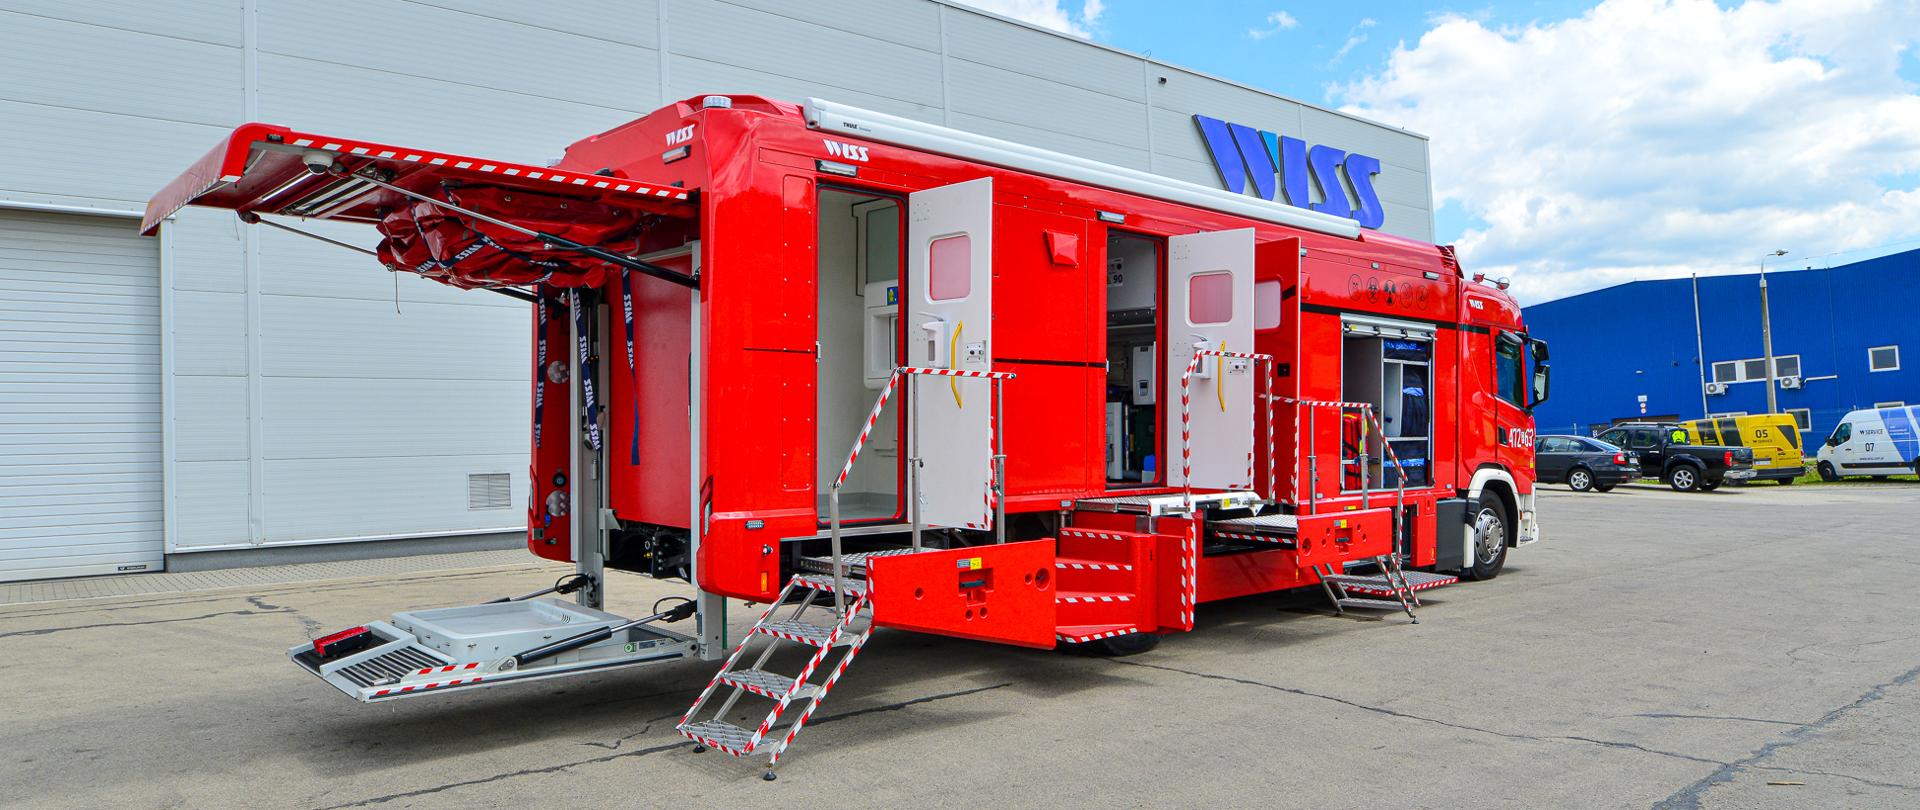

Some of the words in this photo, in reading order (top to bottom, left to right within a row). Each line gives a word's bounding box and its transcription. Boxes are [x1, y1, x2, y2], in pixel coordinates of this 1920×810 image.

[665, 124, 695, 146] WISS
[823, 139, 869, 162] WISS
[1192, 114, 1384, 229] WISS
[1755, 429, 1768, 439] 05
[1865, 443, 1874, 452] 07
